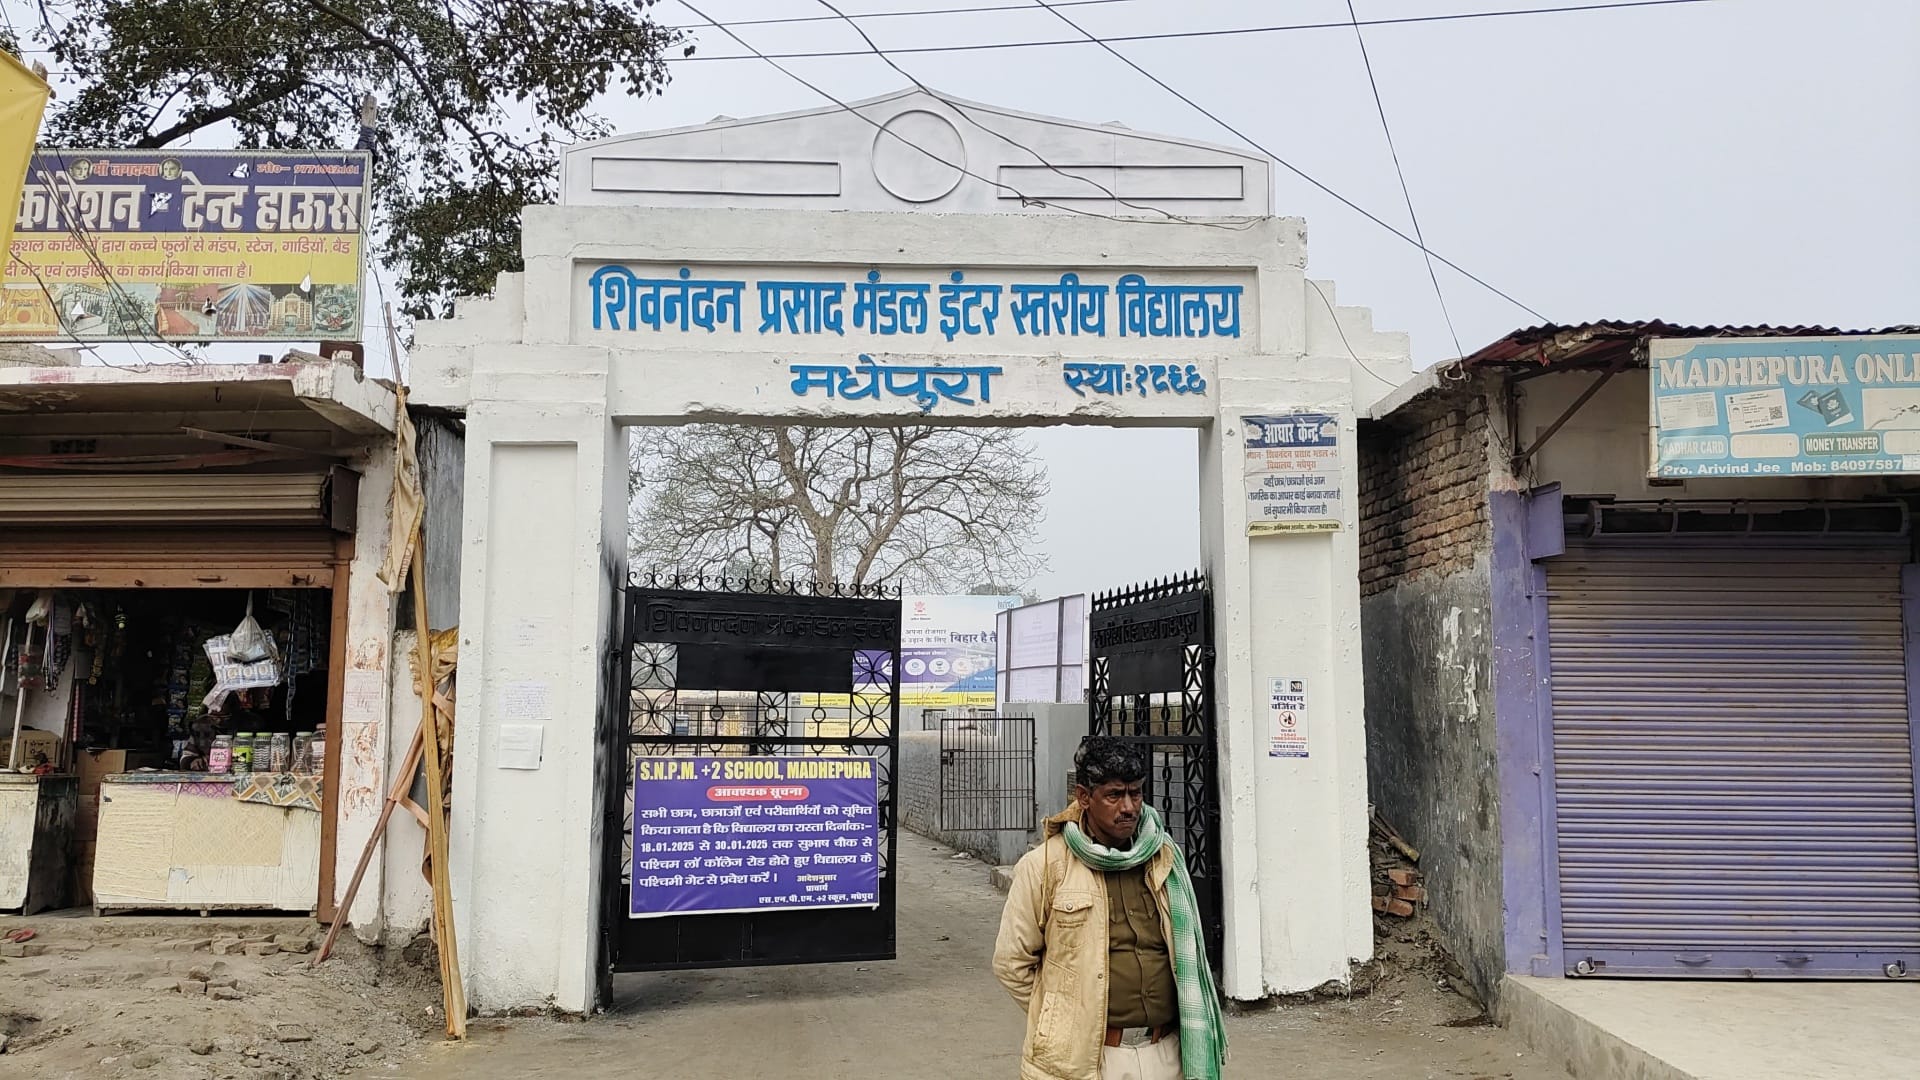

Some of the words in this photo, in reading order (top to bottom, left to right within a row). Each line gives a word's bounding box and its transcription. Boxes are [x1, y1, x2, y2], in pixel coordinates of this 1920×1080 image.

[181, 171, 248, 231] टेन्ट
[255, 185, 363, 231] हाऊस
[102, 239, 125, 253] द्वारा
[130, 236, 157, 252] कच्चे
[194, 237, 204, 252] से
[45, 261, 65, 277] एवं
[117, 265, 134, 277] का
[138, 260, 166, 278] कार्य
[169, 260, 198, 277] किया
[203, 265, 232, 277] जाता
[588, 265, 745, 333] शिवनंदन
[757, 280, 846, 337] प्रसाद
[853, 269, 930, 337] मंडल
[940, 270, 1002, 341] इंटर
[1010, 273, 1109, 338] स्तरीय
[1117, 273, 1243, 339] विद्यालय
[1659, 355, 1849, 389] MADHEPURA
[789, 354, 1003, 414] मधेपुरा
[1264, 423, 1295, 444] आधार
[1663, 441, 1698, 456] AADHAR
[1700, 440, 1725, 454] CARD
[1806, 437, 1835, 452] MONEY
[1837, 436, 1879, 451] TRANSFER
[1663, 465, 1693, 476] Pro.
[1697, 463, 1749, 475] Arivind
[1753, 463, 1780, 473] Jee
[1791, 461, 1826, 472] Mob:
[640, 761, 698, 780] S.N.P.M.
[701, 761, 721, 780] +2
[724, 761, 784, 781] SCHOOL,
[787, 761, 872, 780] MADHEPURA
[714, 787, 767, 798] आवश्यक
[769, 786, 803, 799] सूचना
[641, 806, 667, 819] सभी
[745, 806, 761, 818] एवं
[823, 804, 840, 816] को
[842, 804, 872, 818] सूचित
[641, 823, 671, 836] किया
[672, 824, 702, 835] जाता
[702, 822, 712, 835] है
[713, 822, 729, 834] कि
[731, 822, 776, 834] विद्यालय
[778, 822, 793, 833] का
[795, 822, 824, 833] रास्ता
[640, 841, 694, 853] 18.01.2025
[699, 840, 711, 851] से
[714, 840, 768, 851] 30.01.2025
[772, 839, 793, 850] तक
[798, 838, 830, 851] सुभाष
[834, 836, 858, 848] चौक
[862, 836, 872, 848] से
[640, 857, 680, 871] पश्चिम
[684, 856, 702, 869] लॉ
[704, 856, 743, 868] कॉलेज
[746, 854, 765, 867] रोड
[769, 854, 790, 866] होते
[794, 855, 810, 868] हुए
[813, 854, 857, 866] विद्यालय
[860, 853, 872, 864] के
[640, 874, 682, 888] पश्चिमी
[686, 874, 706, 886] गेट
[706, 874, 718, 886] से
[720, 874, 748, 886] प्रवेश
